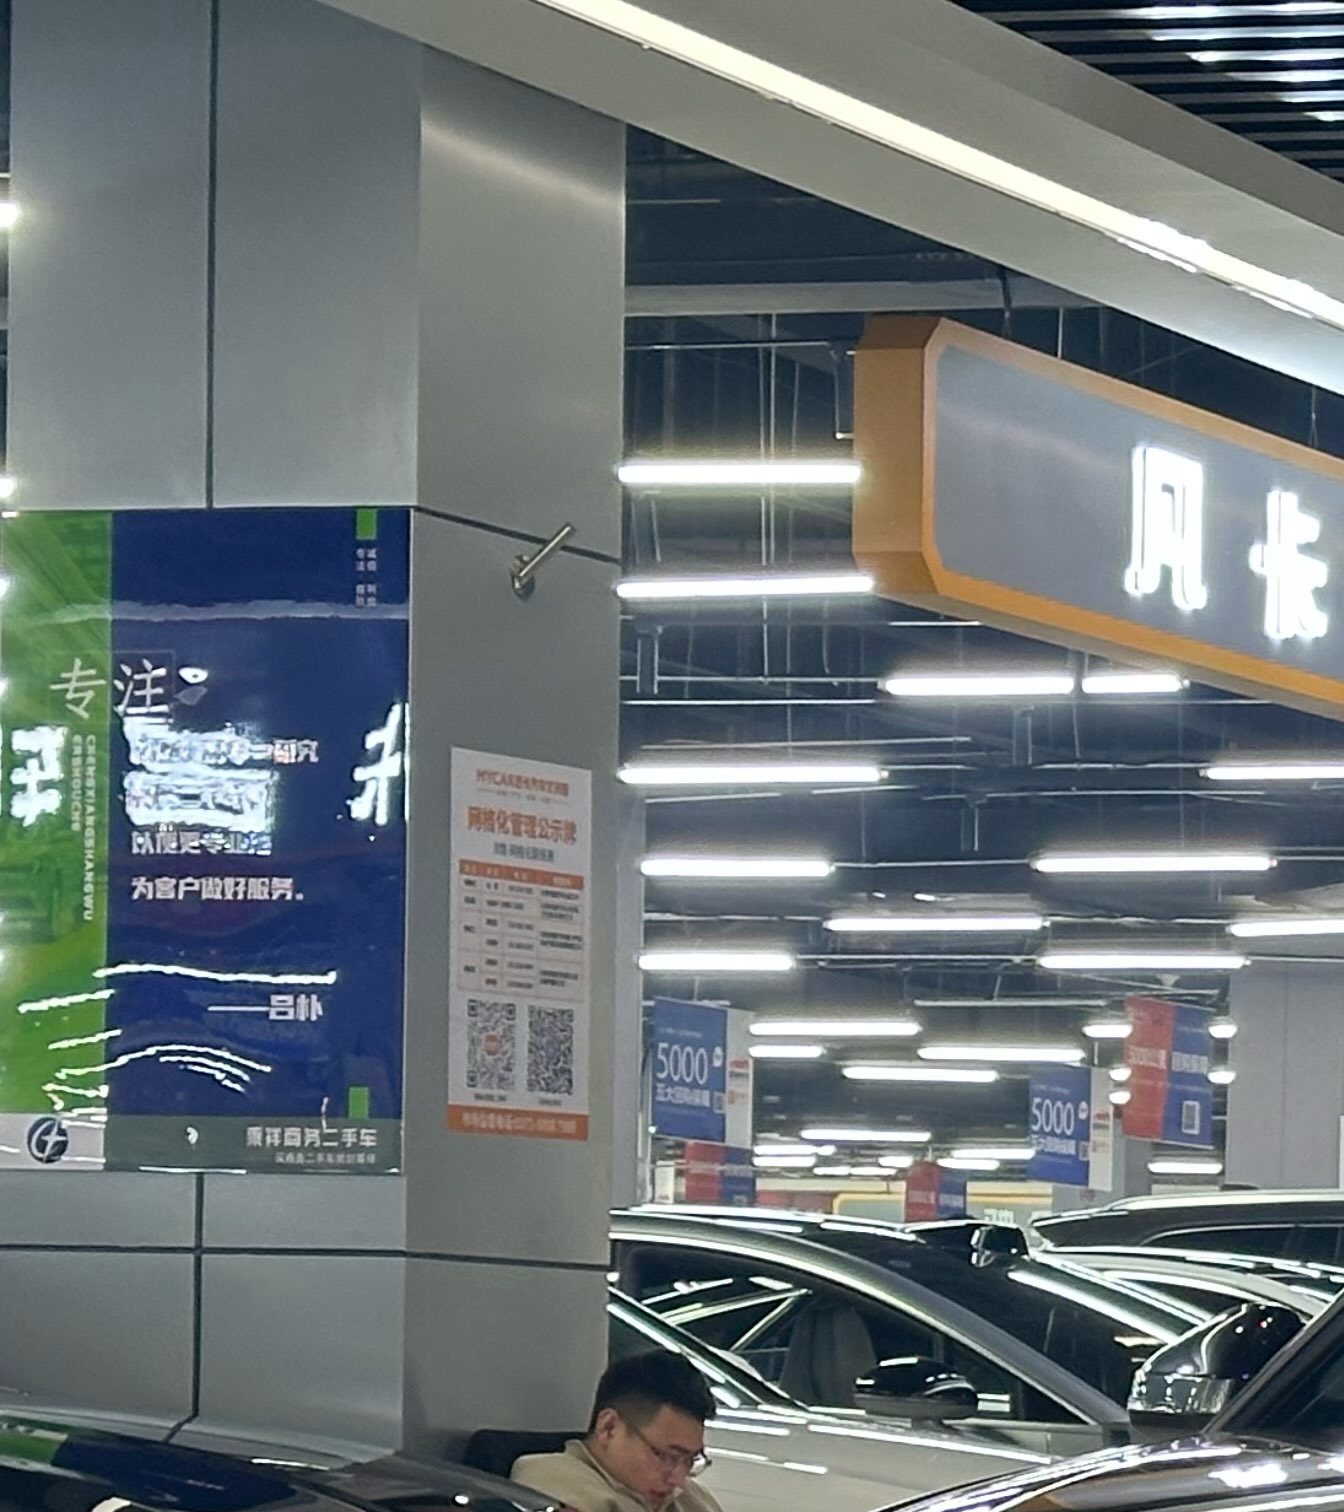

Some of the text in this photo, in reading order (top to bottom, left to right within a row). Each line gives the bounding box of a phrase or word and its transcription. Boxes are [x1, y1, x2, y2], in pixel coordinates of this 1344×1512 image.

[49, 656, 169, 720] 专注
[656, 1042, 708, 1085] 5000
[1031, 1097, 1075, 1136] 5000
